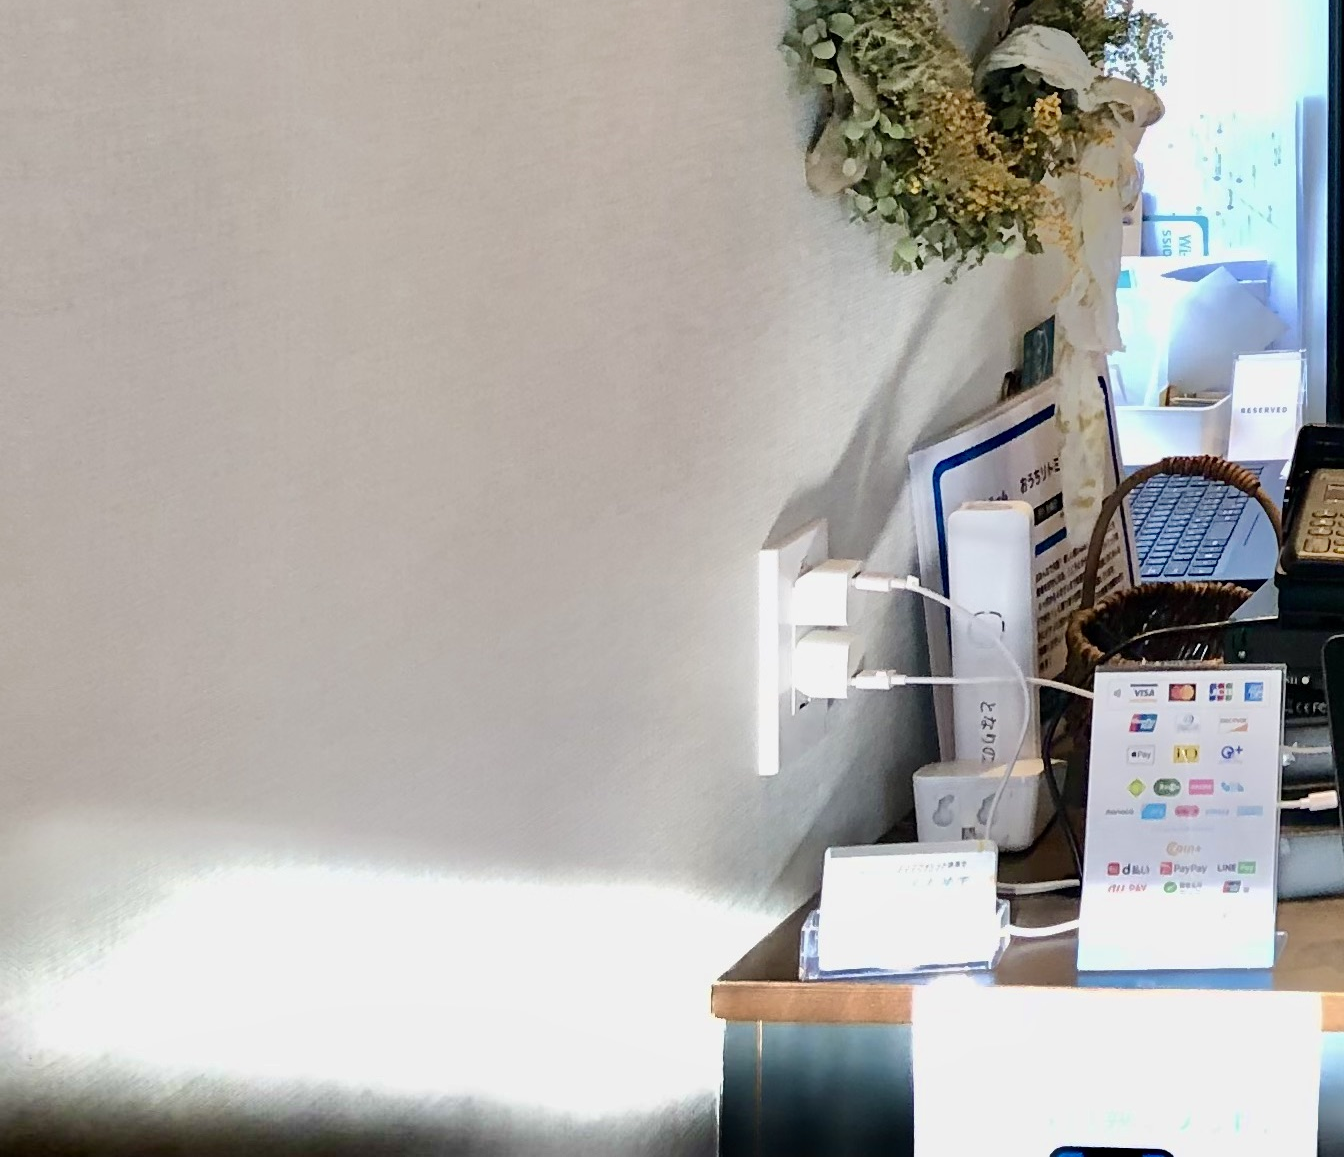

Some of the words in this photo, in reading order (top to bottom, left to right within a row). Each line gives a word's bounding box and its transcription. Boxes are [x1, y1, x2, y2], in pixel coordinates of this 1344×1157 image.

[1162, 229, 1172, 257] SSID
[1240, 406, 1288, 414] RESERVED
[1020, 456, 1061, 494] おうちリトミ
[1134, 688, 1155, 697] VISA
